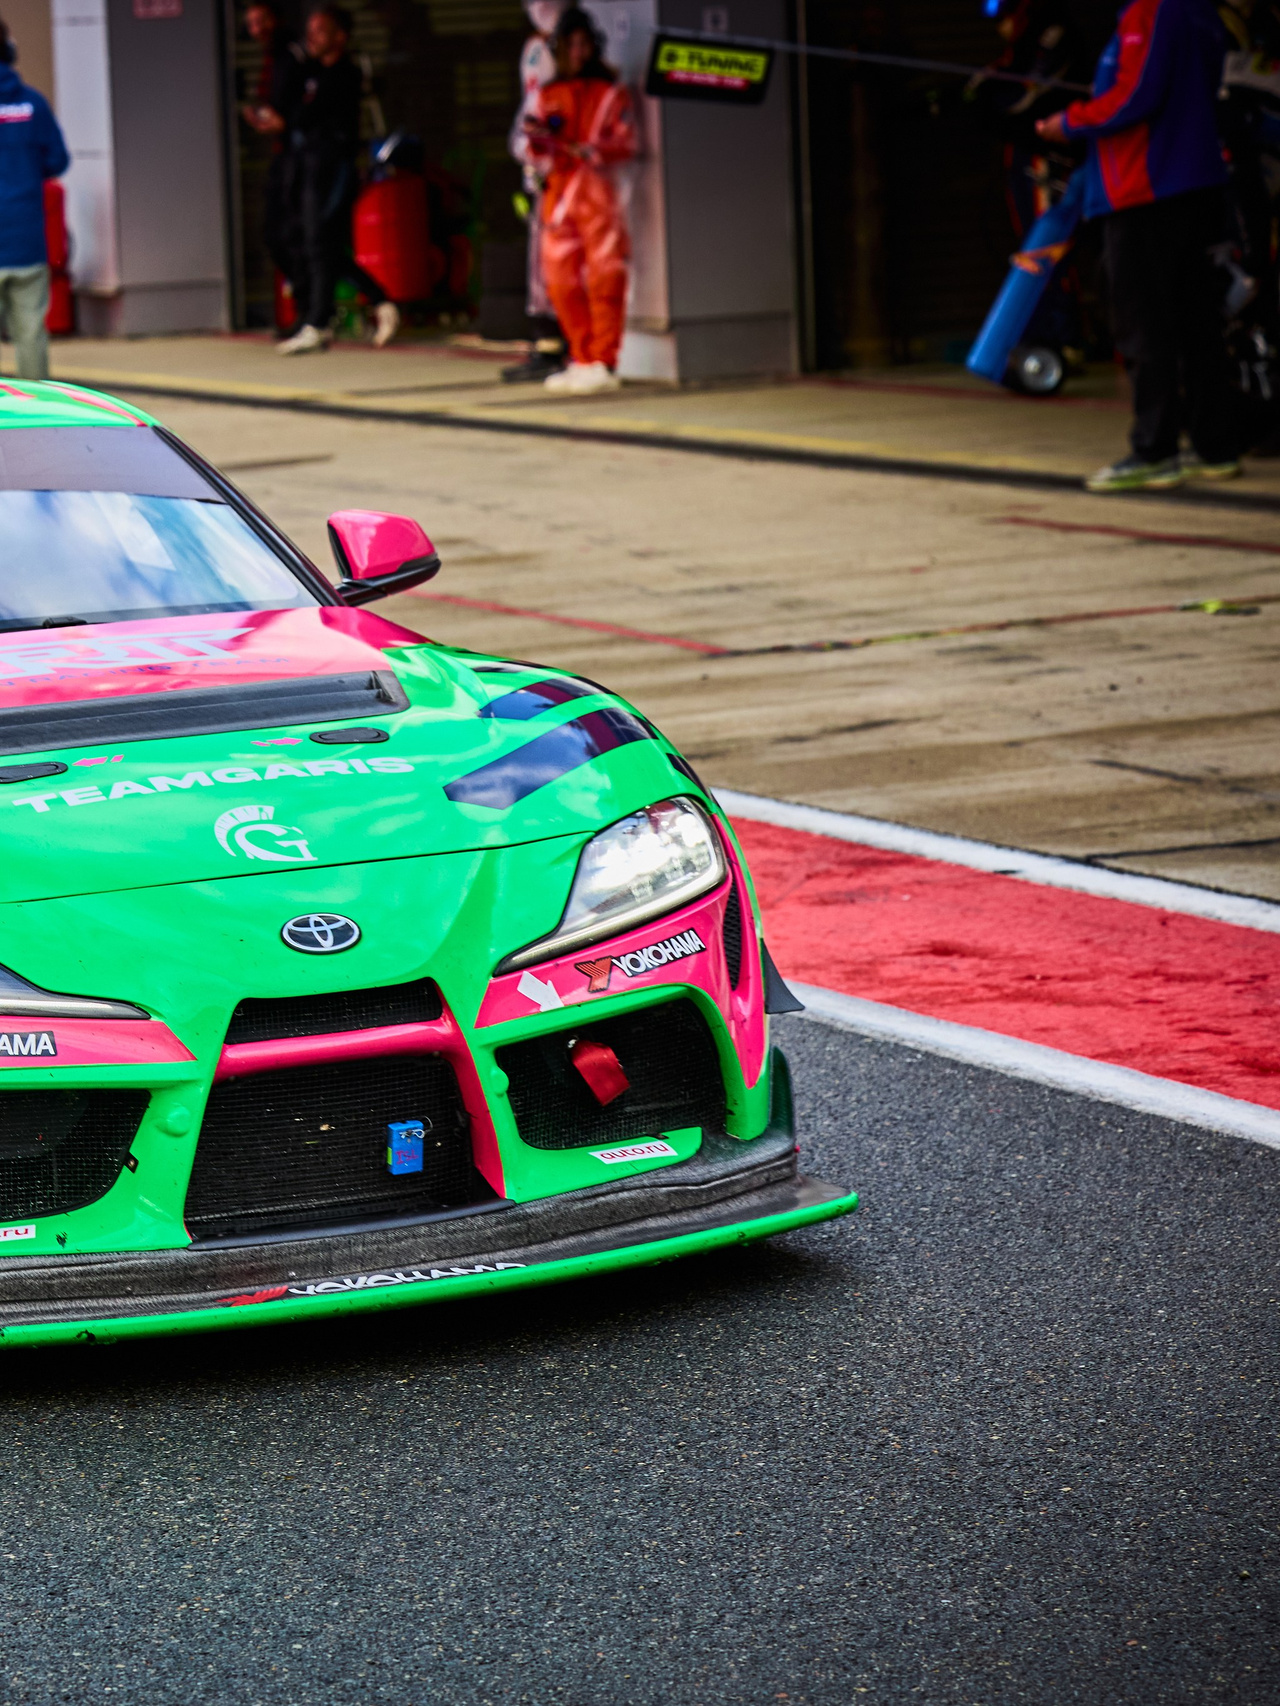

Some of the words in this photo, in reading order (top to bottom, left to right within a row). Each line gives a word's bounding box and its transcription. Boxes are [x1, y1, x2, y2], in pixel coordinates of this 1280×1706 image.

[12, 757, 415, 813] TEAMGARIS
[610, 929, 707, 978] YOKOHAMA
[599, 1143, 670, 1160] auto.ru
